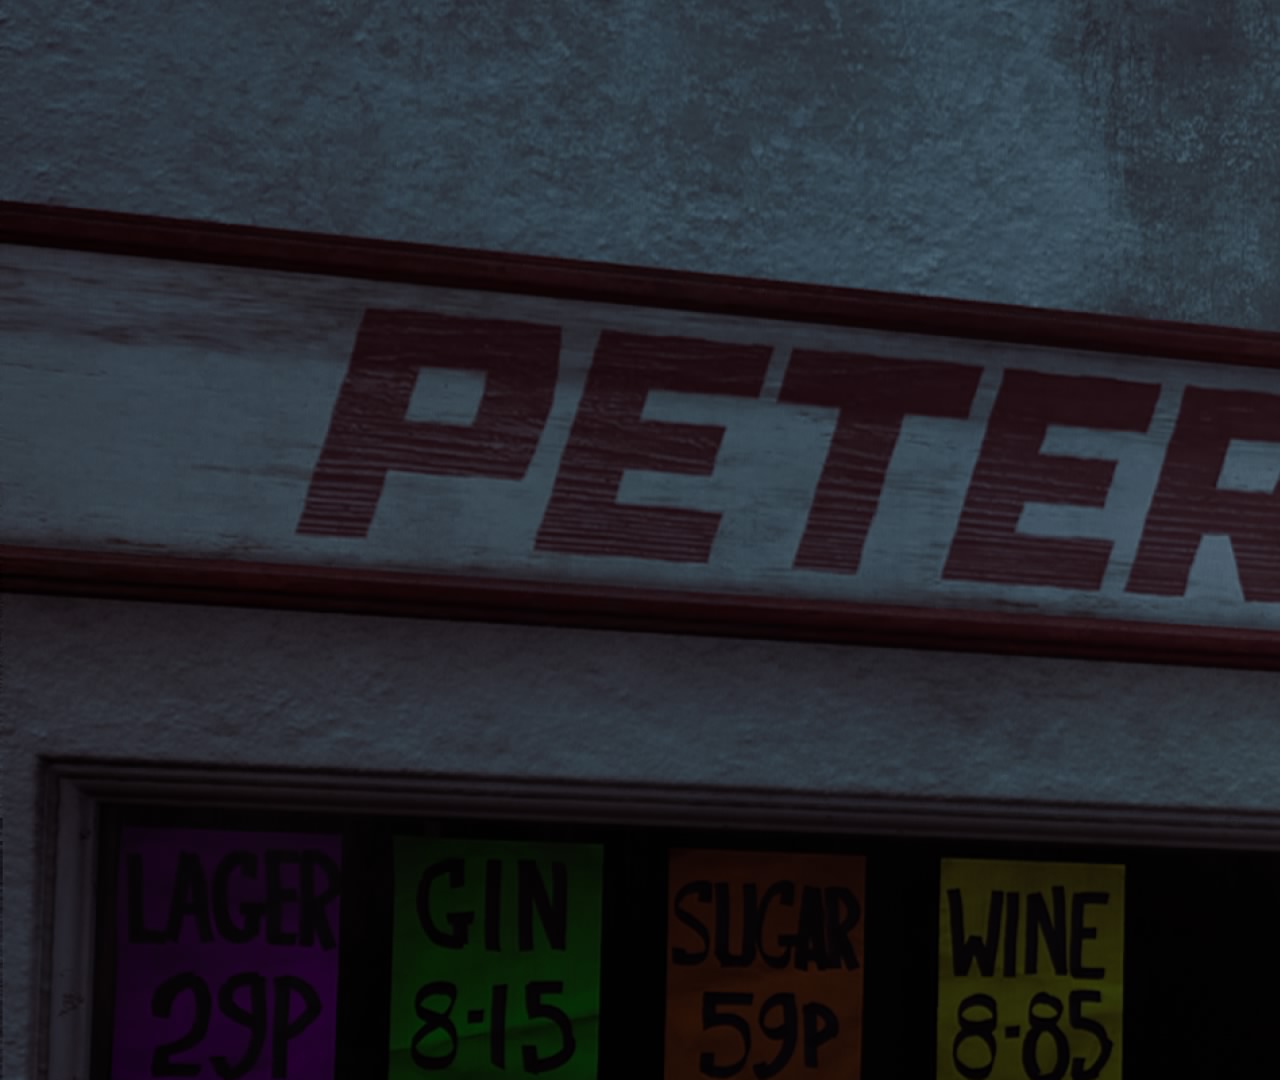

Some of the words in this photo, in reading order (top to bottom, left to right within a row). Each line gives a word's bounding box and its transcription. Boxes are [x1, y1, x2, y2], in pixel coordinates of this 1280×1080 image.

[126, 850, 342, 951] LAGER
[417, 858, 568, 951] GIN
[671, 879, 861, 971] SUGAR
[948, 886, 1109, 979] WINE
